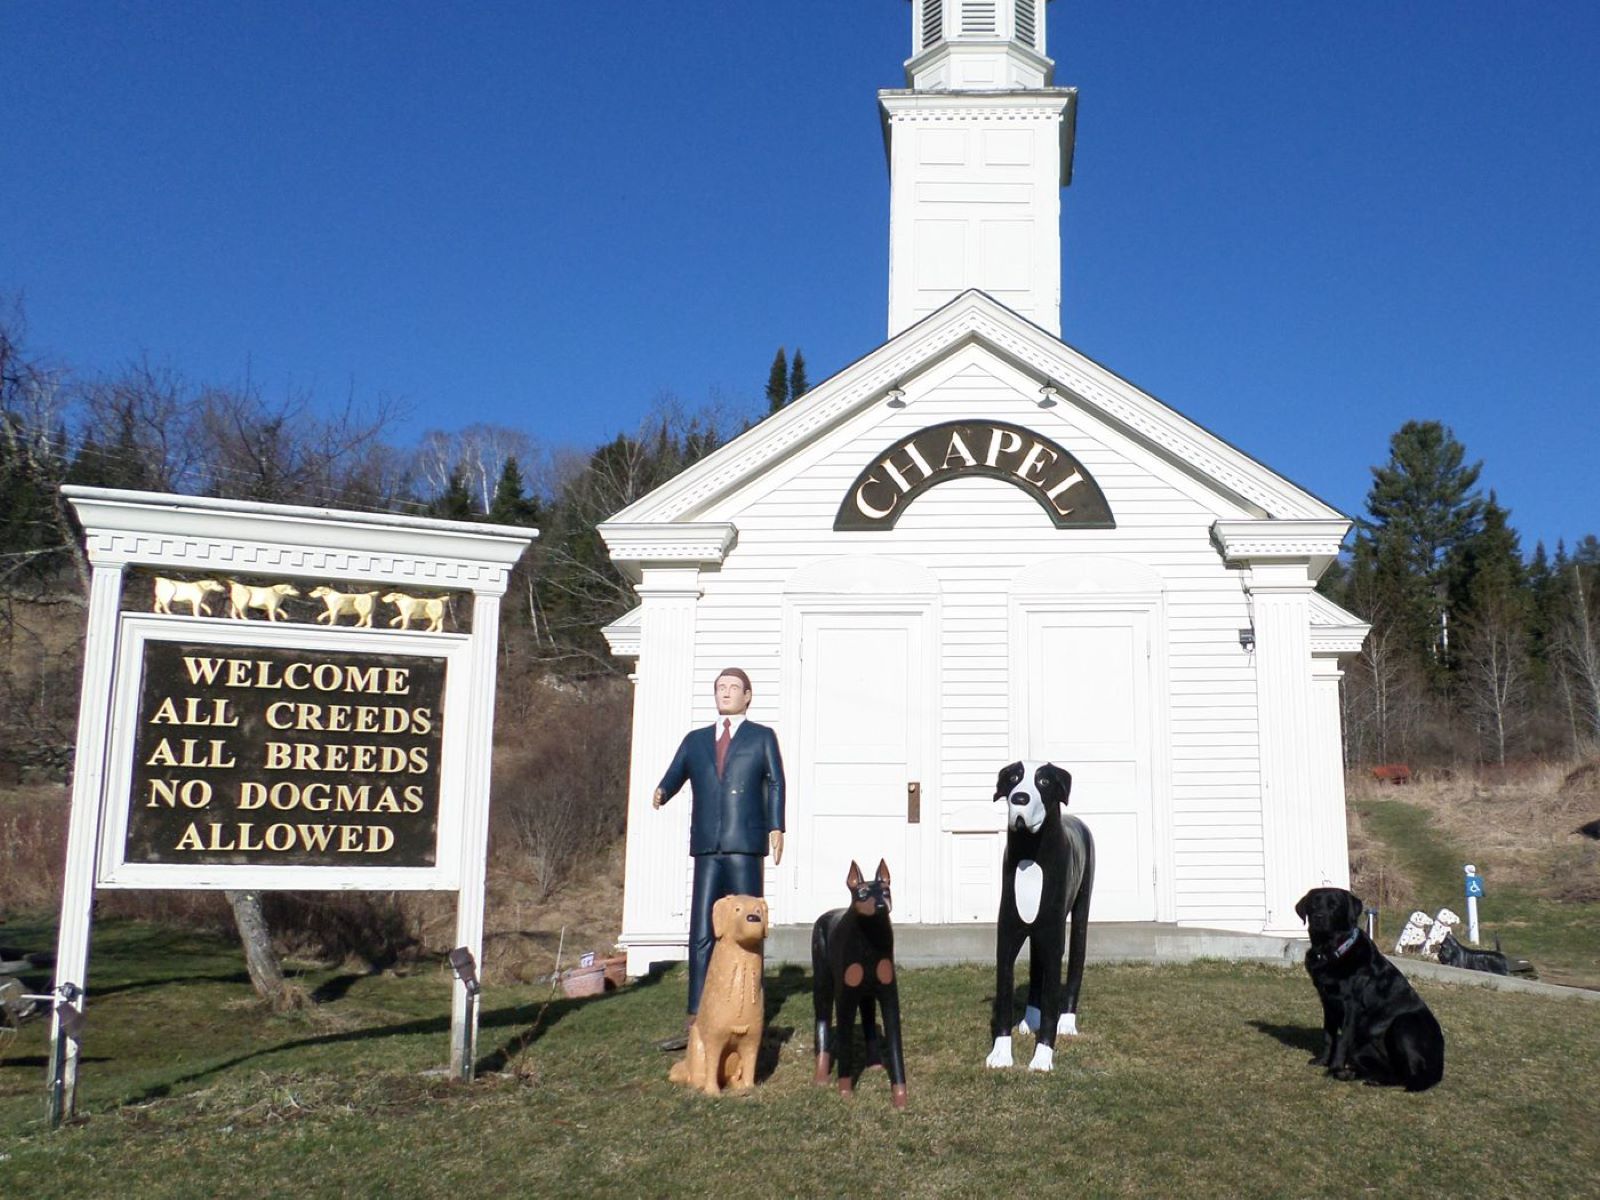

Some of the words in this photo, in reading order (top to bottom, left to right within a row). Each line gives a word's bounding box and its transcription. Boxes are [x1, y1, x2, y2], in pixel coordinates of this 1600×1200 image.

[856, 427, 1086, 519] CHAPEL
[183, 656, 410, 695] WELCOME
[149, 697, 239, 727] ALL
[265, 701, 431, 734] CREEDS
[146, 738, 236, 769] ALL
[264, 742, 429, 774] BREEDS
[146, 779, 212, 808] NO
[238, 782, 424, 814] DOGMAS
[175, 822, 395, 852] ALLOWED
